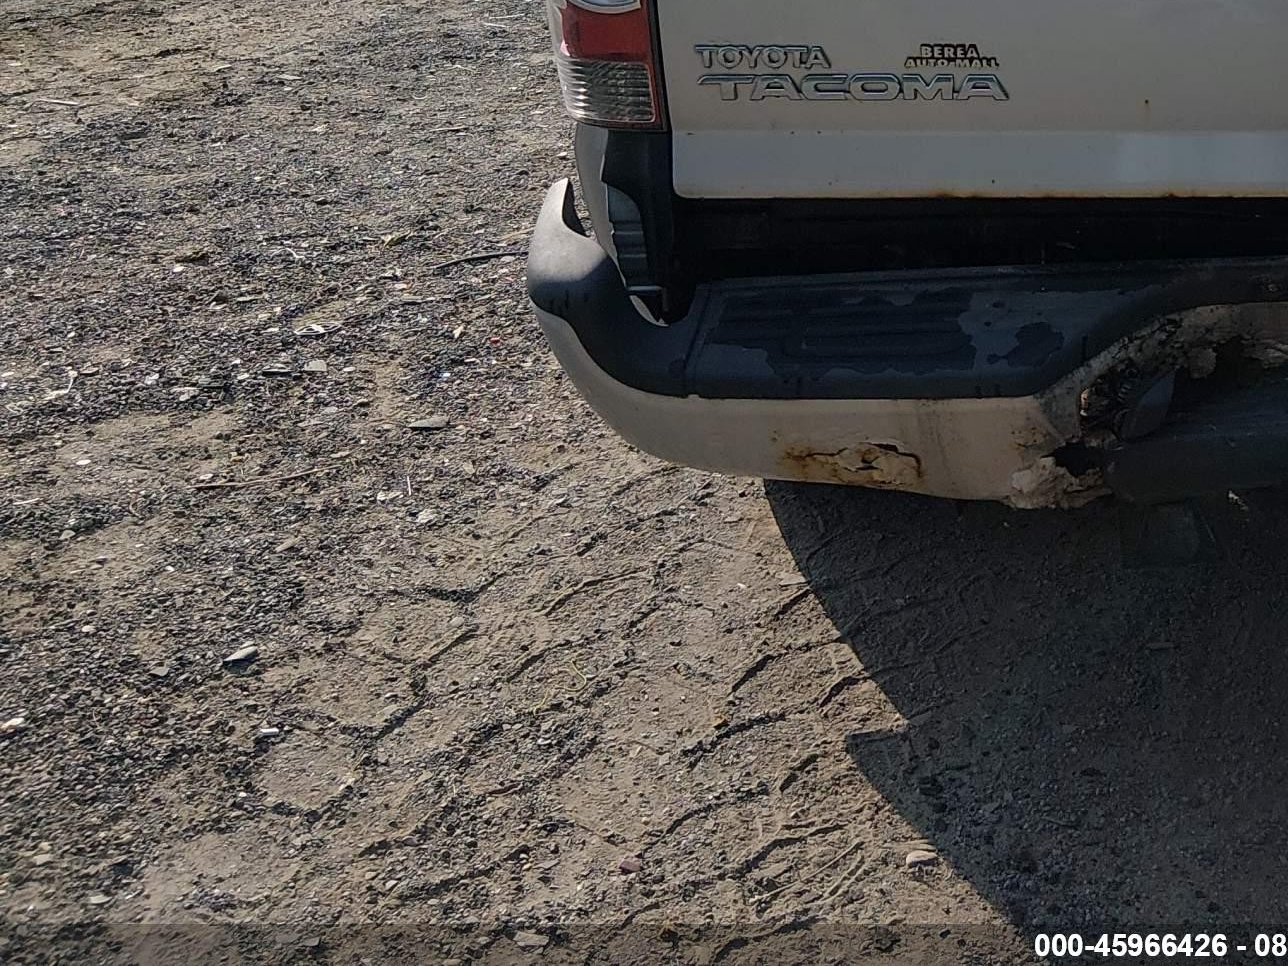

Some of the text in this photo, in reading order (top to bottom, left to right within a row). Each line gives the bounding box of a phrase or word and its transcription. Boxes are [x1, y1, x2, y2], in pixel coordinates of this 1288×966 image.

[696, 45, 831, 69] TOYOTA
[919, 44, 980, 59] BEREA
[697, 74, 1010, 101] TACOMA
